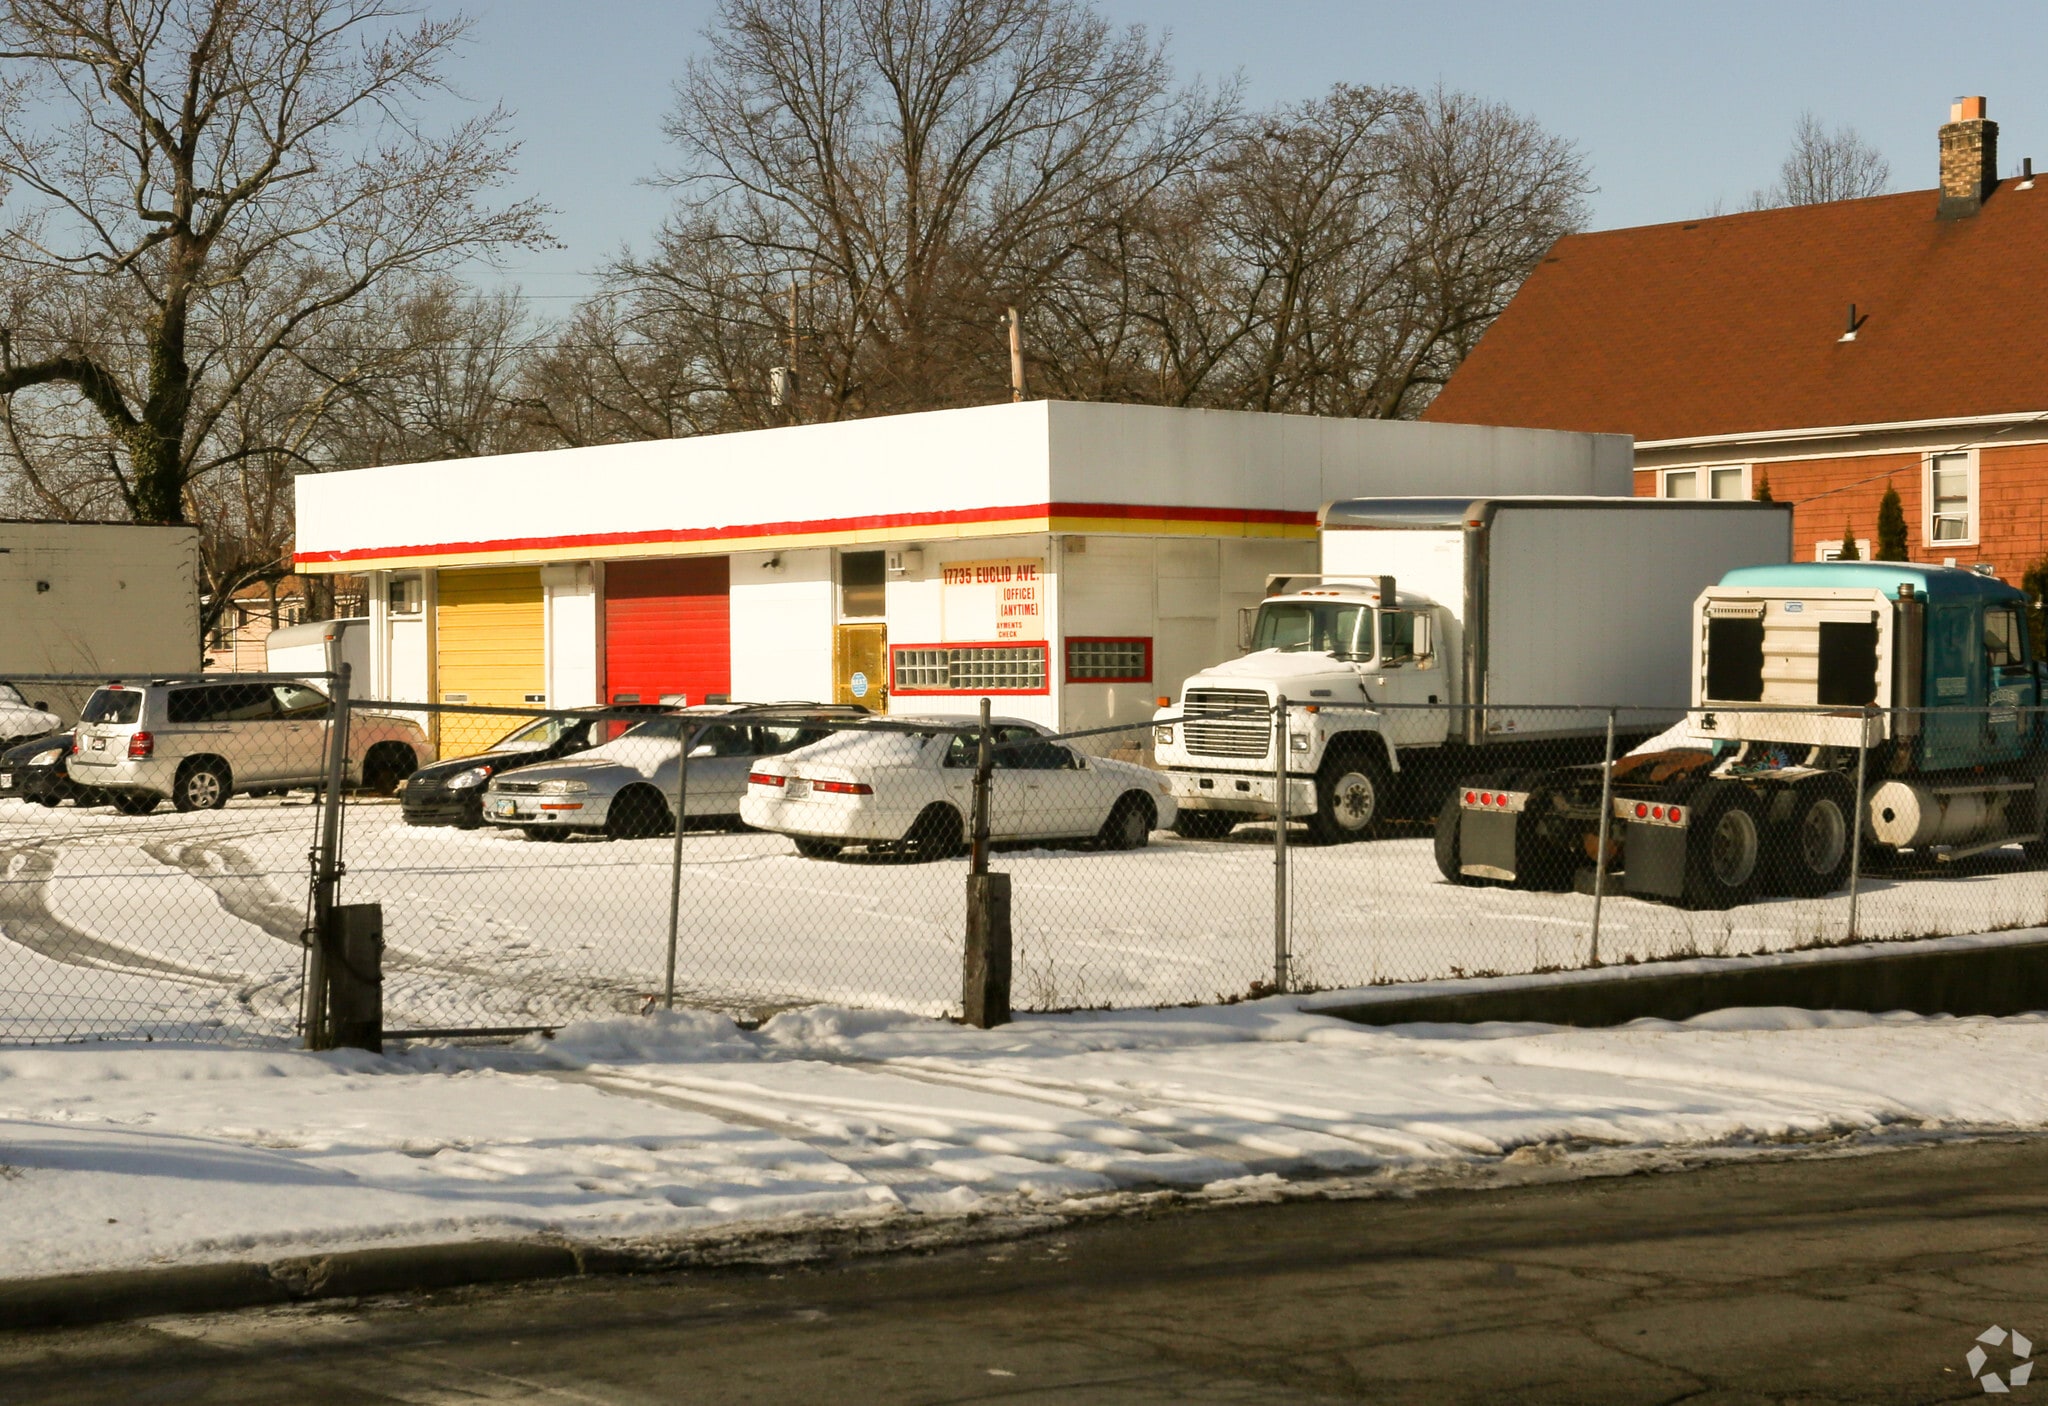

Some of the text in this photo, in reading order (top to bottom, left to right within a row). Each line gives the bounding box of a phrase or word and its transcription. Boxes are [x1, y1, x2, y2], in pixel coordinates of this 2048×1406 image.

[943, 564, 1040, 585] 17735 EUCLID AVE.
